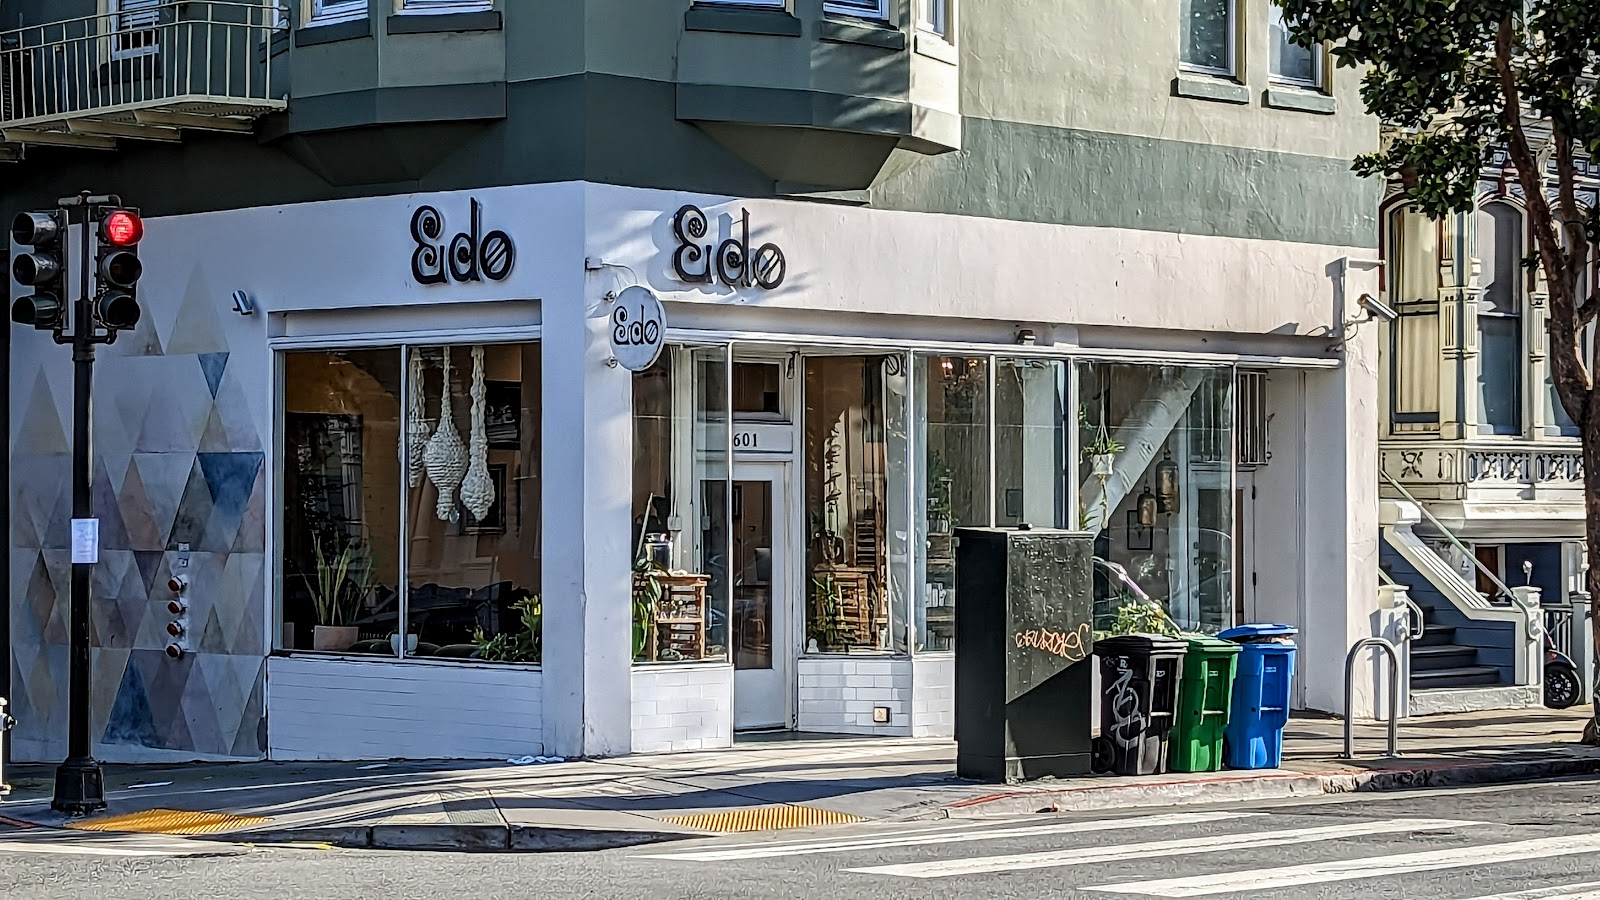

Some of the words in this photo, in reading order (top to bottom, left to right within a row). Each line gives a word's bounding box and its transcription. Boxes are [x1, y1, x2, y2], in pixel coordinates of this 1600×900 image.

[411, 198, 515, 284] Edo
[672, 205, 786, 290] Edo
[613, 305, 659, 346] Edo
[733, 432, 757, 447] 601
